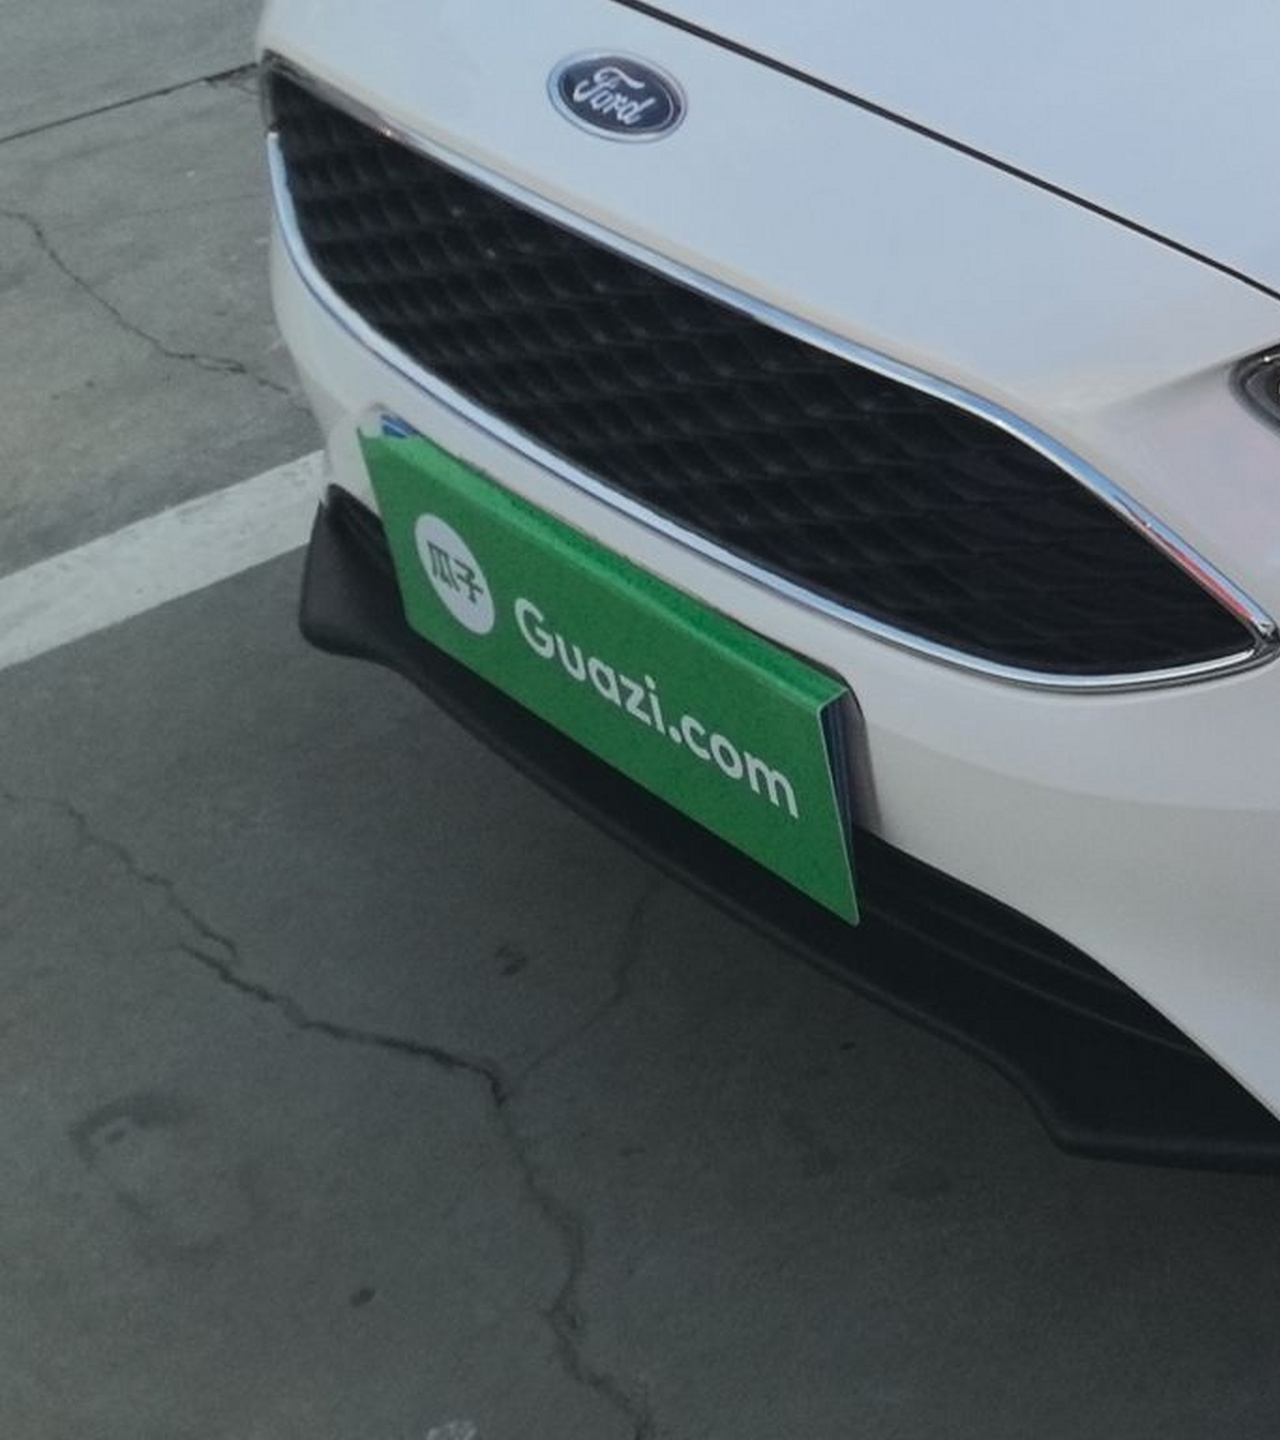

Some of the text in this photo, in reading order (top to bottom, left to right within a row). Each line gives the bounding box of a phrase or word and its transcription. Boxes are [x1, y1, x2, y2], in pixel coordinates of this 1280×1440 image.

[572, 66, 656, 125] Ford
[426, 539, 484, 606] 瓜子
[514, 597, 799, 820] Guazi.com
